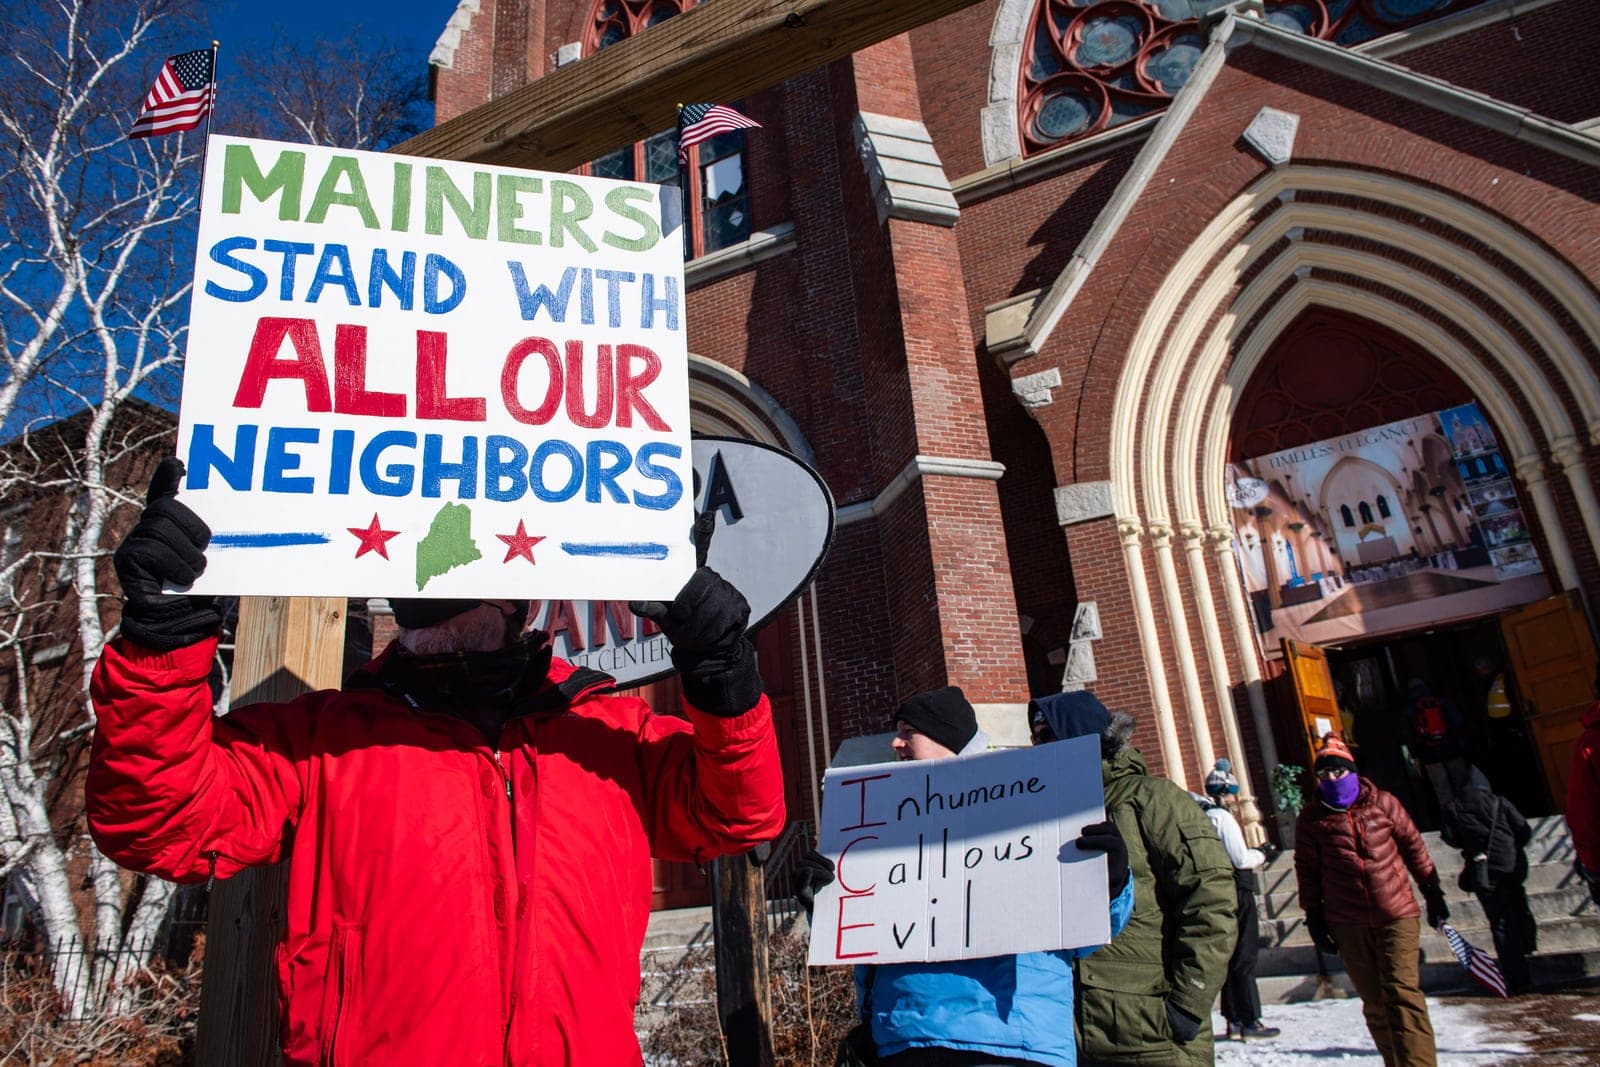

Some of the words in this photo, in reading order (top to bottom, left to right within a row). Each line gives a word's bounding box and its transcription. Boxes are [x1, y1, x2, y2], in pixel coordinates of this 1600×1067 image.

[222, 145, 661, 253] MAINERS
[204, 236, 467, 315] STAND
[508, 261, 680, 331] WITH
[233, 317, 487, 422] ALL
[500, 337, 673, 432] OUR
[185, 424, 683, 511] NEIGHBORS
[598, 637, 672, 671] CENTER
[840, 774, 1046, 832] Inhumane
[837, 828, 1034, 893] Callous
[836, 879, 972, 959] Evil
